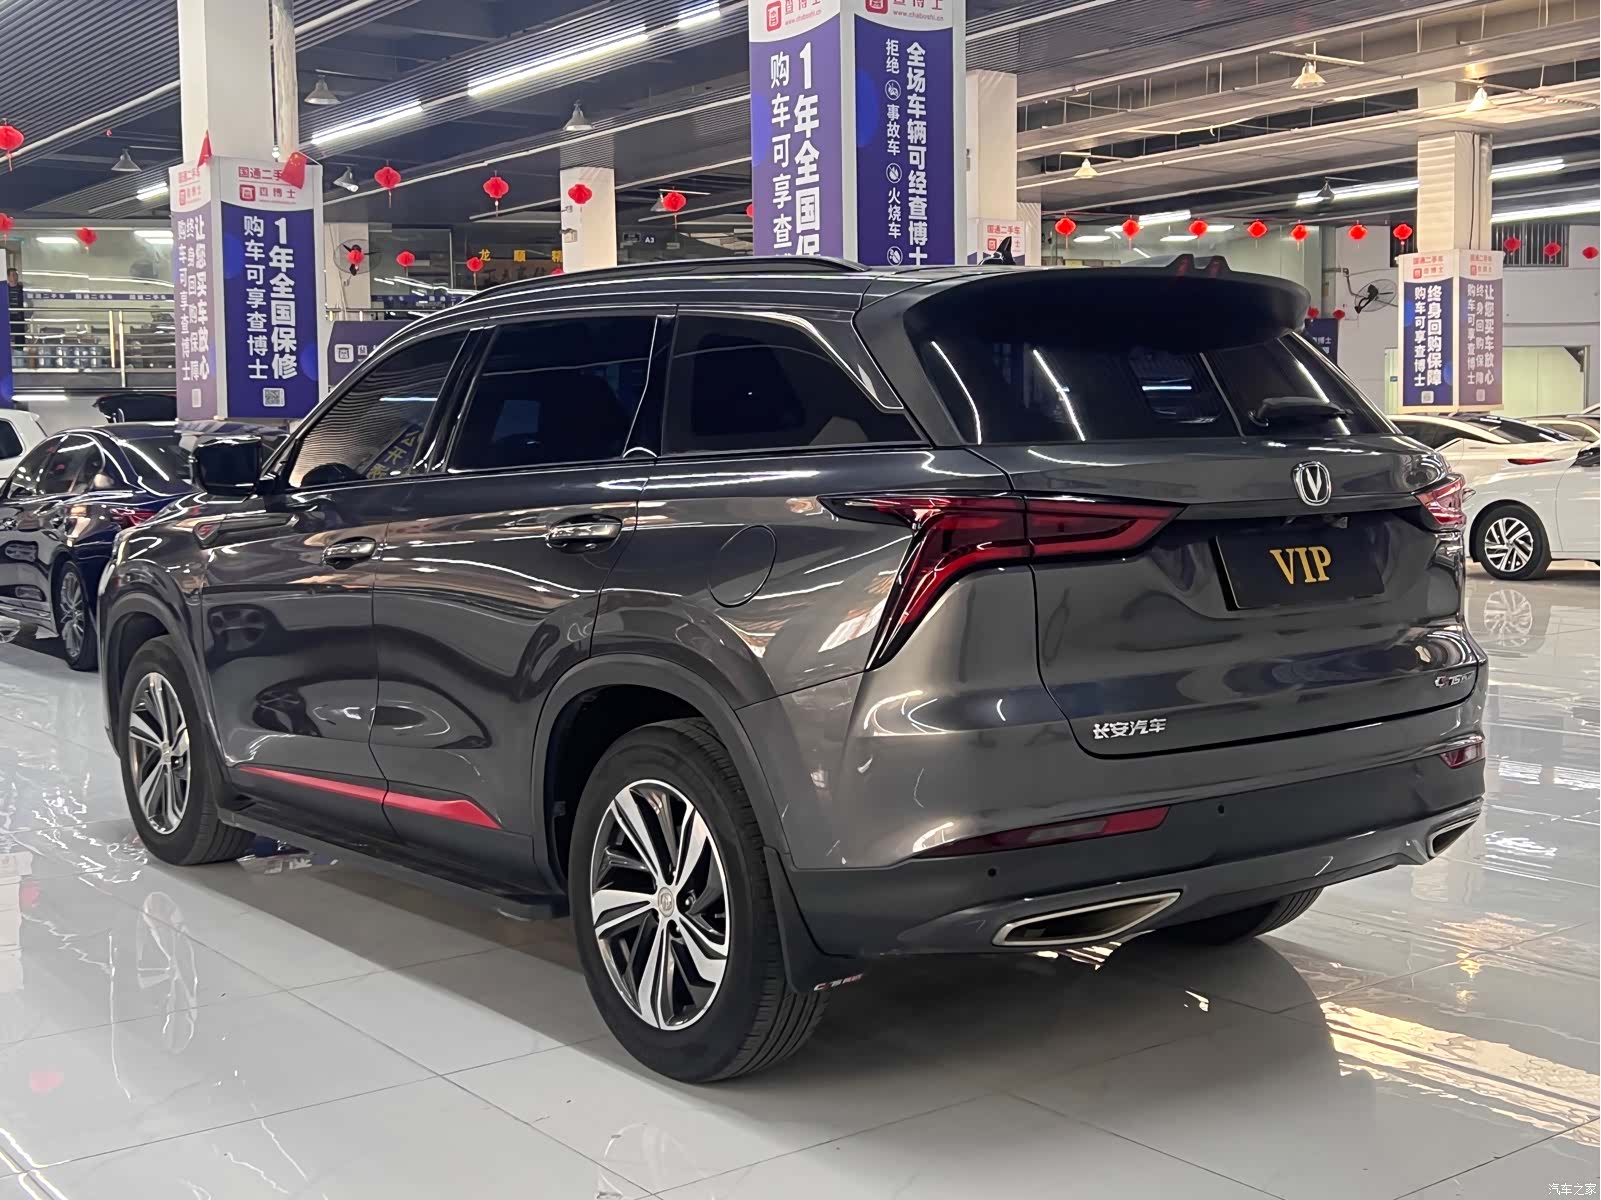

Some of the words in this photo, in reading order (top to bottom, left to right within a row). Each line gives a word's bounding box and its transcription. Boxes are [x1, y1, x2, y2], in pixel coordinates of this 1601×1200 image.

[885, 38, 900, 75] 拒绝
[238, 166, 285, 181] 国通二手
[770, 51, 793, 256] 购车可享查
[886, 103, 901, 156] 事故车
[887, 187, 902, 239] 火烧车
[243, 215, 269, 380] 购车可享查博士
[268, 217, 298, 380] 1年全国保修
[1414, 285, 1427, 387] 购车可享查博士
[1427, 284, 1442, 386] 终身回购保障
[1467, 284, 1476, 385] 购车可享查博士
[1484, 284, 1495, 385] 让您买车放心
[1270, 546, 1332, 585] VIP
[1093, 718, 1167, 739] 长安汽车
